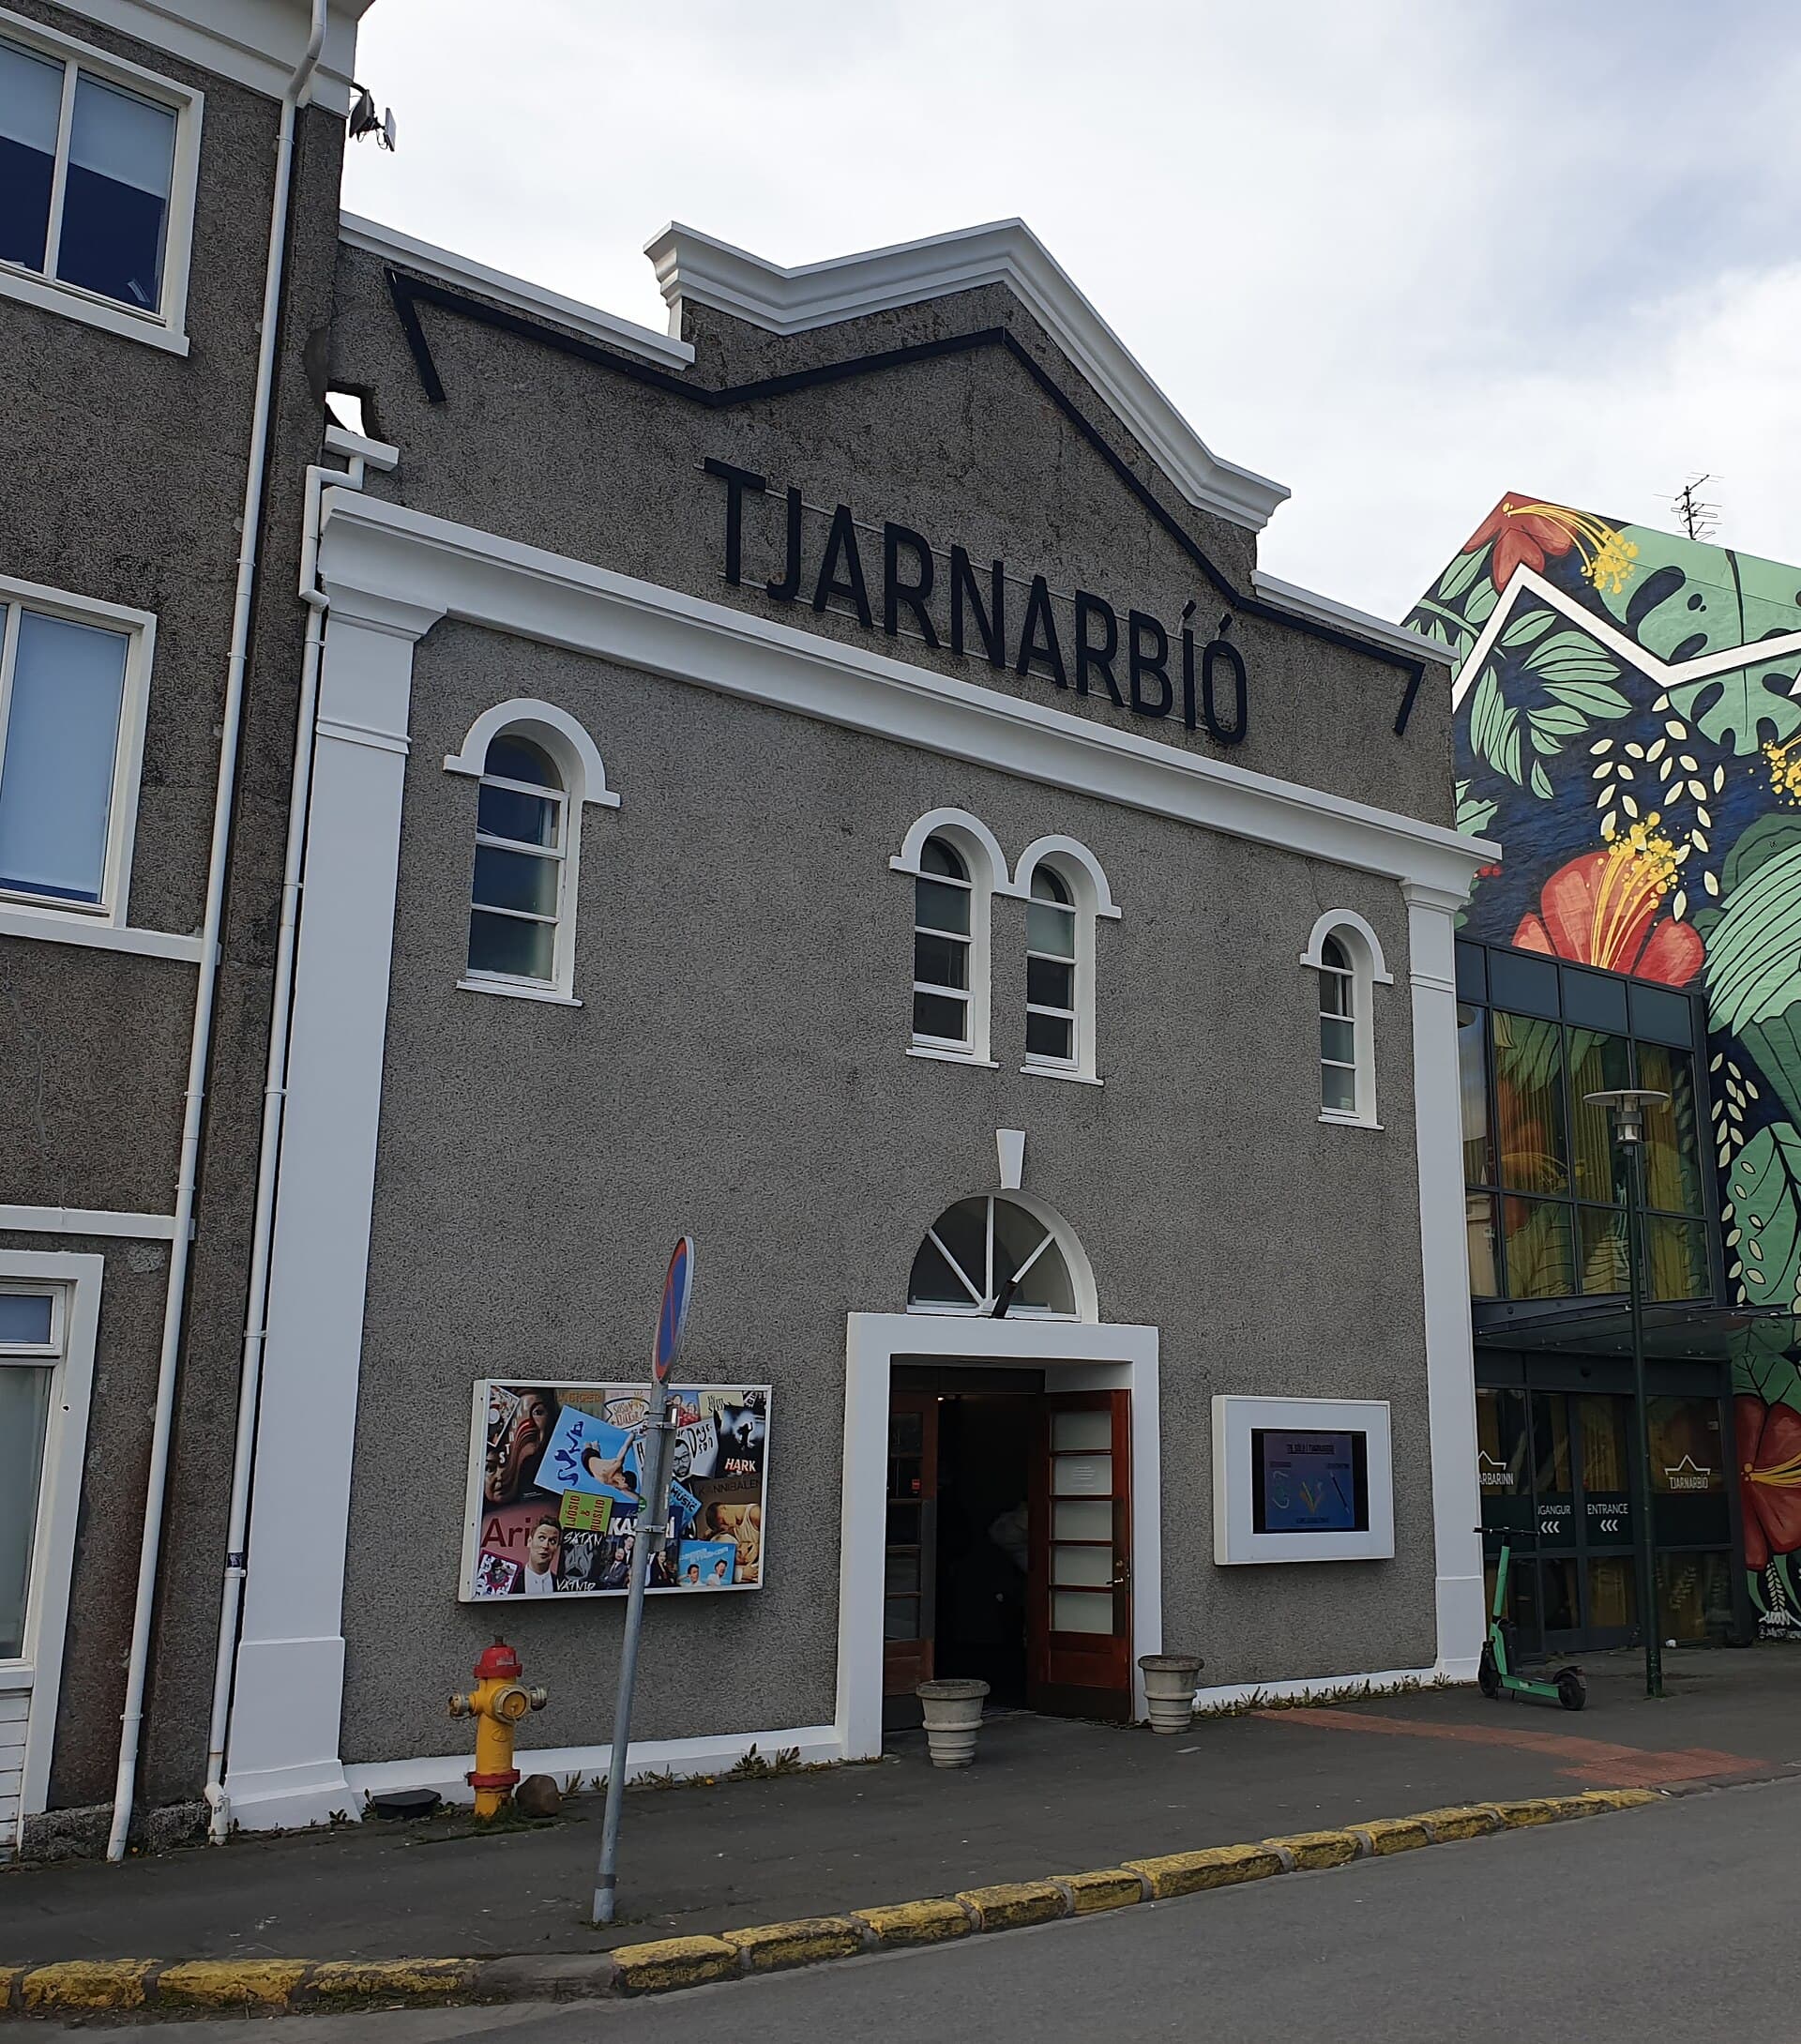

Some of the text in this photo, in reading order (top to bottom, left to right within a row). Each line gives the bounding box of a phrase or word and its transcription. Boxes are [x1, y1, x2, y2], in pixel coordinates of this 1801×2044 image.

[704, 457, 1248, 745] TJARNARBÍÓ
[724, 1458, 756, 1473] HARK
[1477, 1472, 1514, 1486] ARBARINN
[670, 1487, 697, 1512] MUSIC
[1587, 1503, 1628, 1516] ENTRANCE
[482, 1517, 531, 1548] Ari
